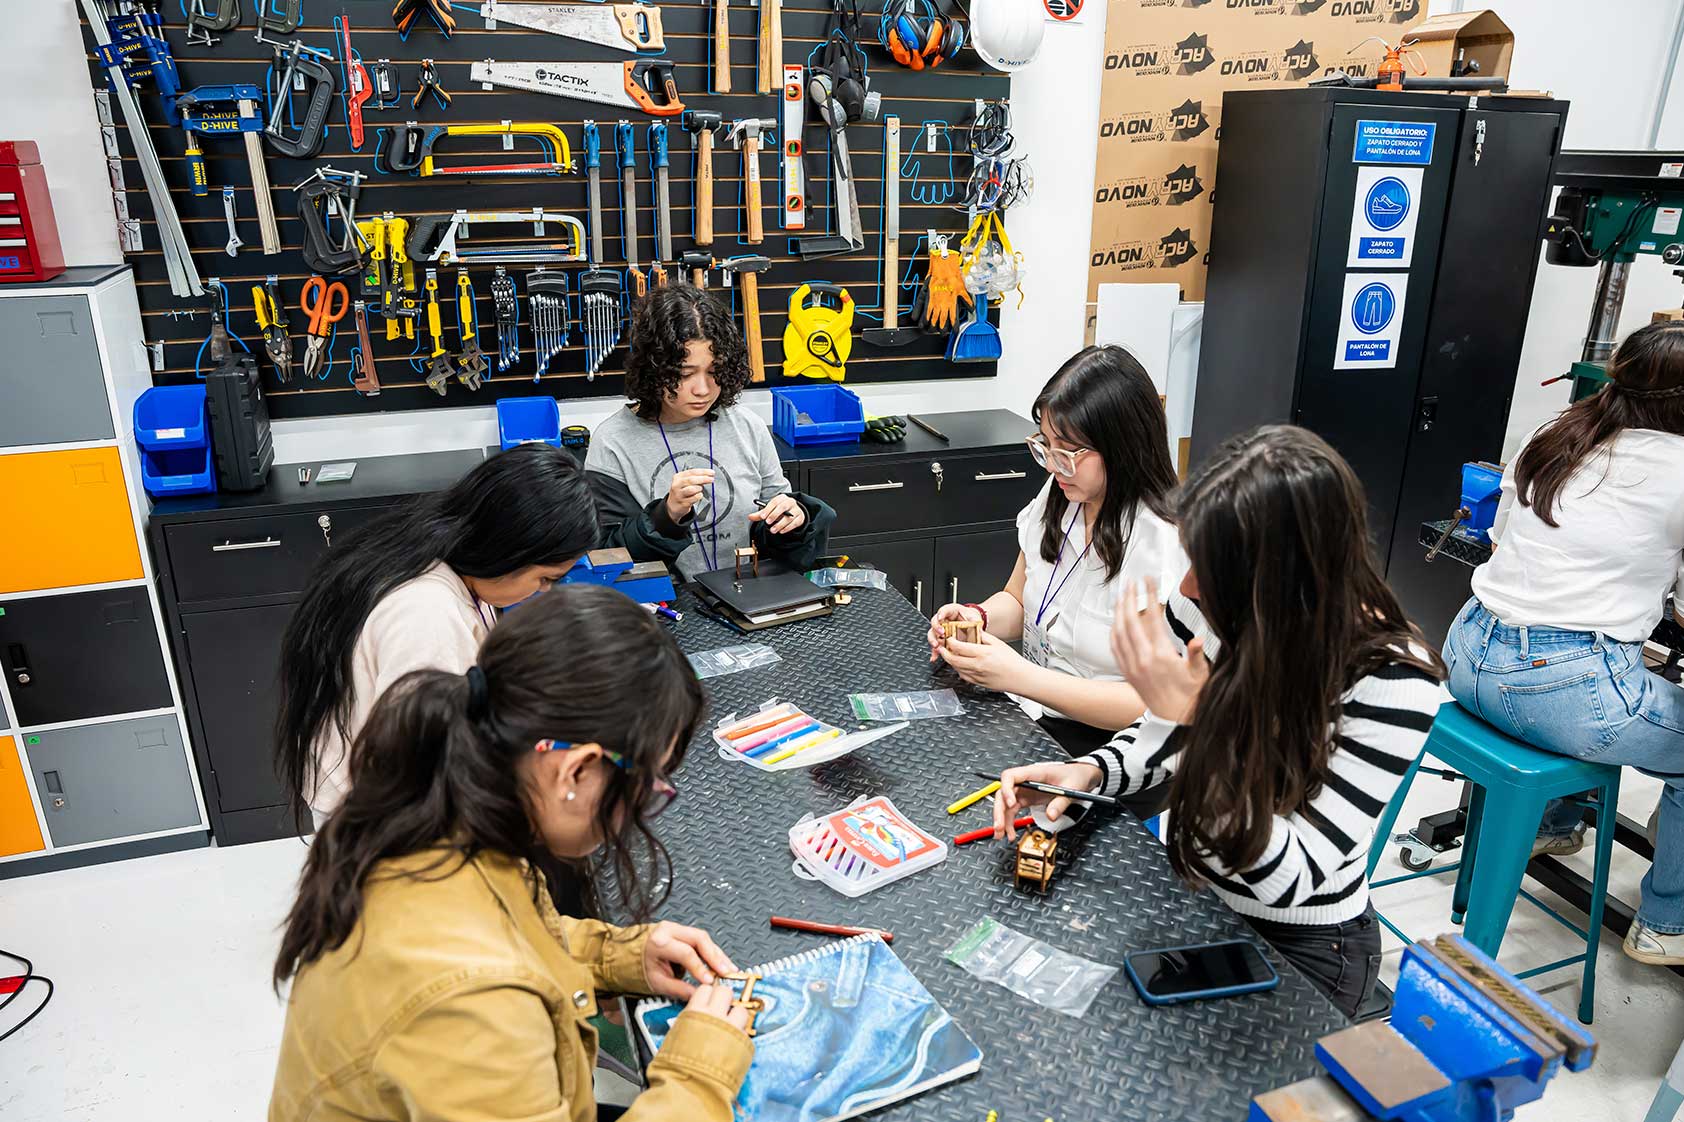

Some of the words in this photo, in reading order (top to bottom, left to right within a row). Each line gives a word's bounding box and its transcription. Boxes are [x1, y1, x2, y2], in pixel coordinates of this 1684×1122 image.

[547, 71, 589, 87] TACTIX
[201, 121, 239, 131] D-HIVE
[1363, 126, 1379, 135] USO
[1380, 127, 1428, 137] OBLIGATORIO:
[1367, 138, 1390, 146] ZAPATO
[1391, 139, 1417, 147] CERRADO
[1366, 146, 1396, 156] PANTALÓN
[1396, 148, 1405, 156] DE
[192, 162, 202, 186] IRWIN
